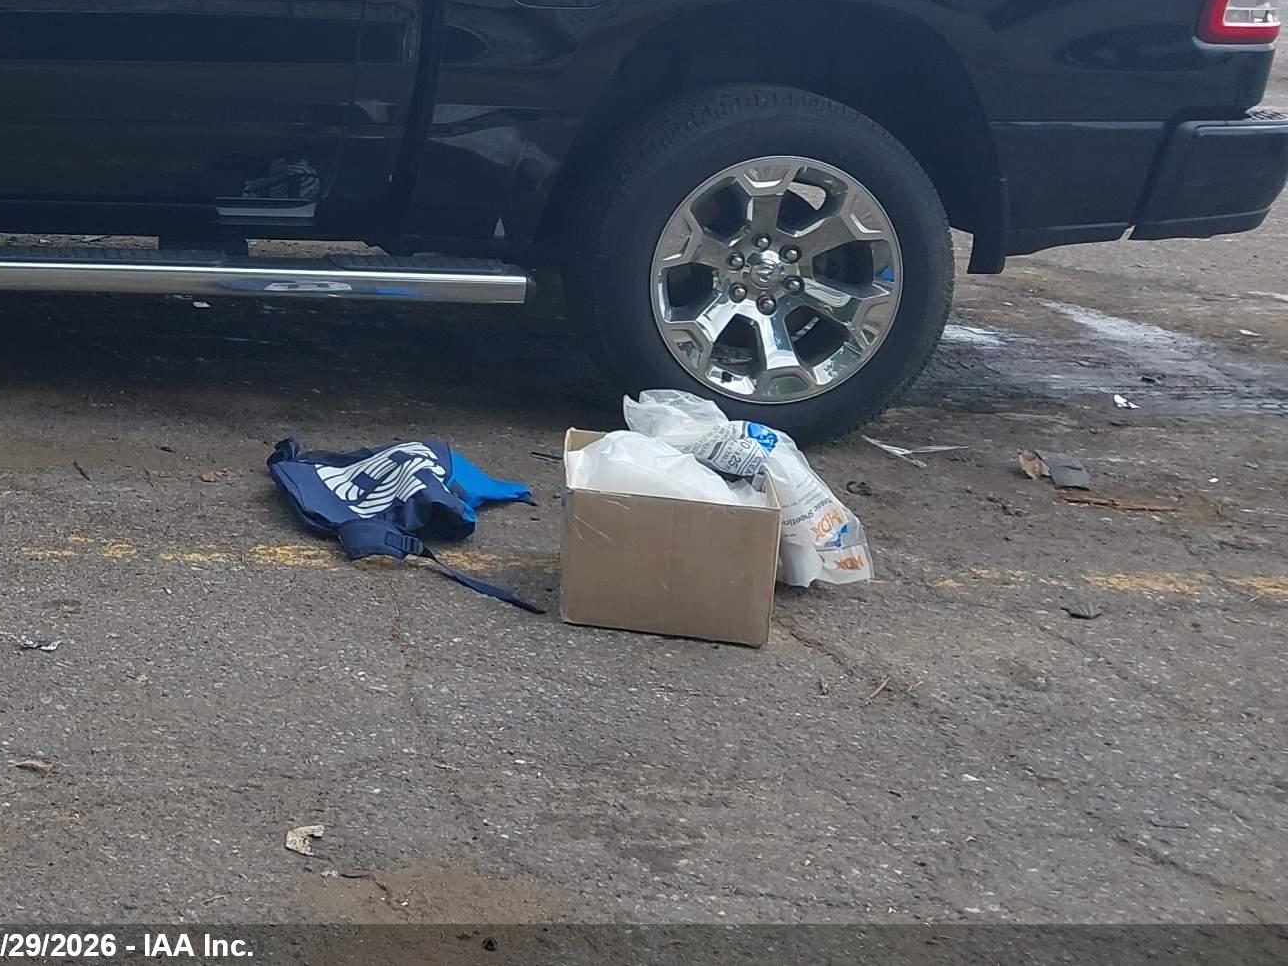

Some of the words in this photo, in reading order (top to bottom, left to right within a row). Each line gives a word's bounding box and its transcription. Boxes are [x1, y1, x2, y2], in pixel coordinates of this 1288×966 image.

[728, 454, 742, 468] 25
[745, 456, 761, 474] CLEA
[781, 509, 814, 527] Sheetin
